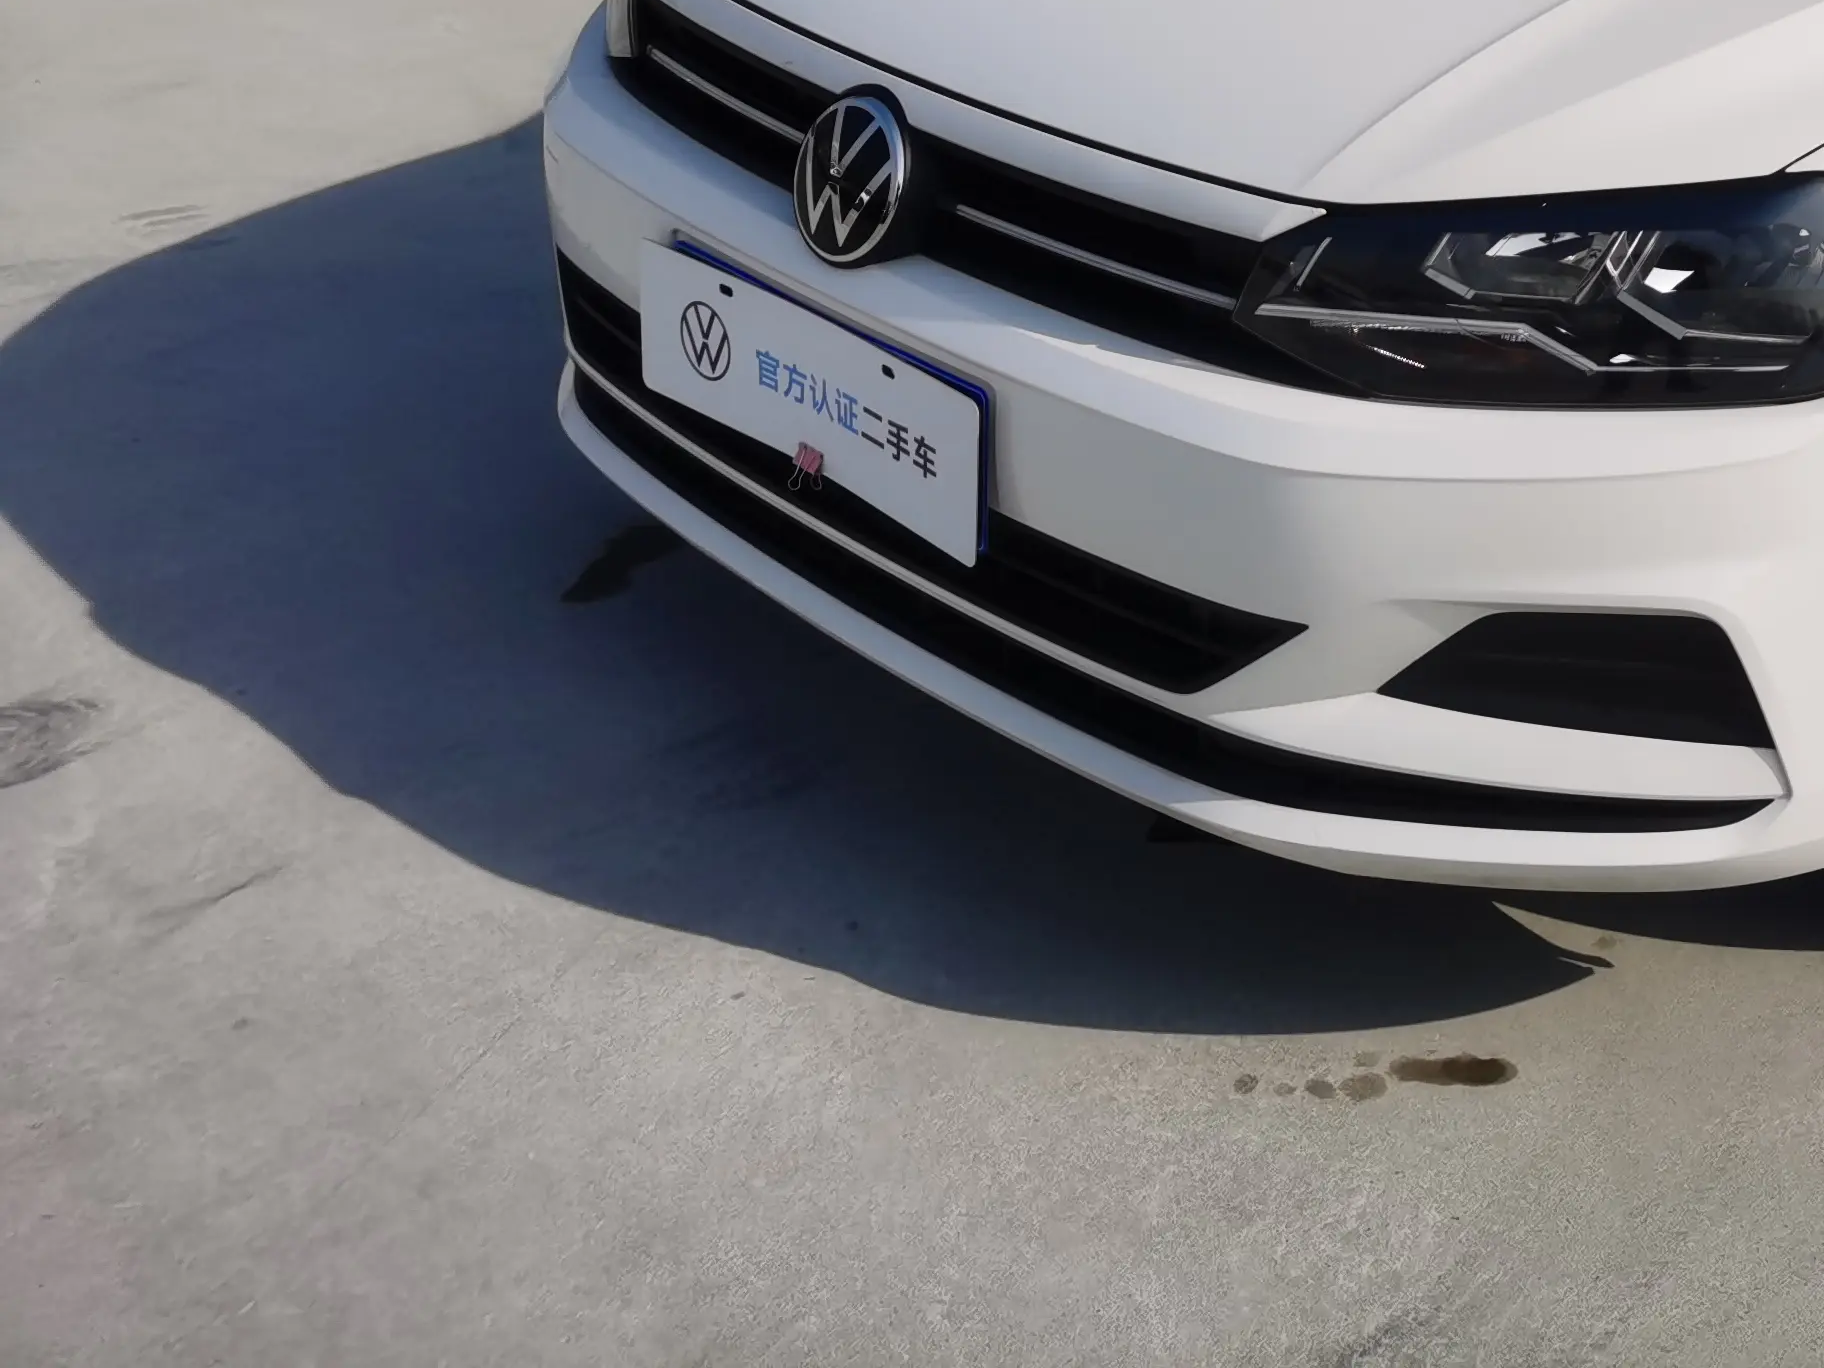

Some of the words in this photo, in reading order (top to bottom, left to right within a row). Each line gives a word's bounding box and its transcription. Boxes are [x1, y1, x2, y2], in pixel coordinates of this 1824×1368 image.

[755, 349, 938, 480] 官方认证二手车
